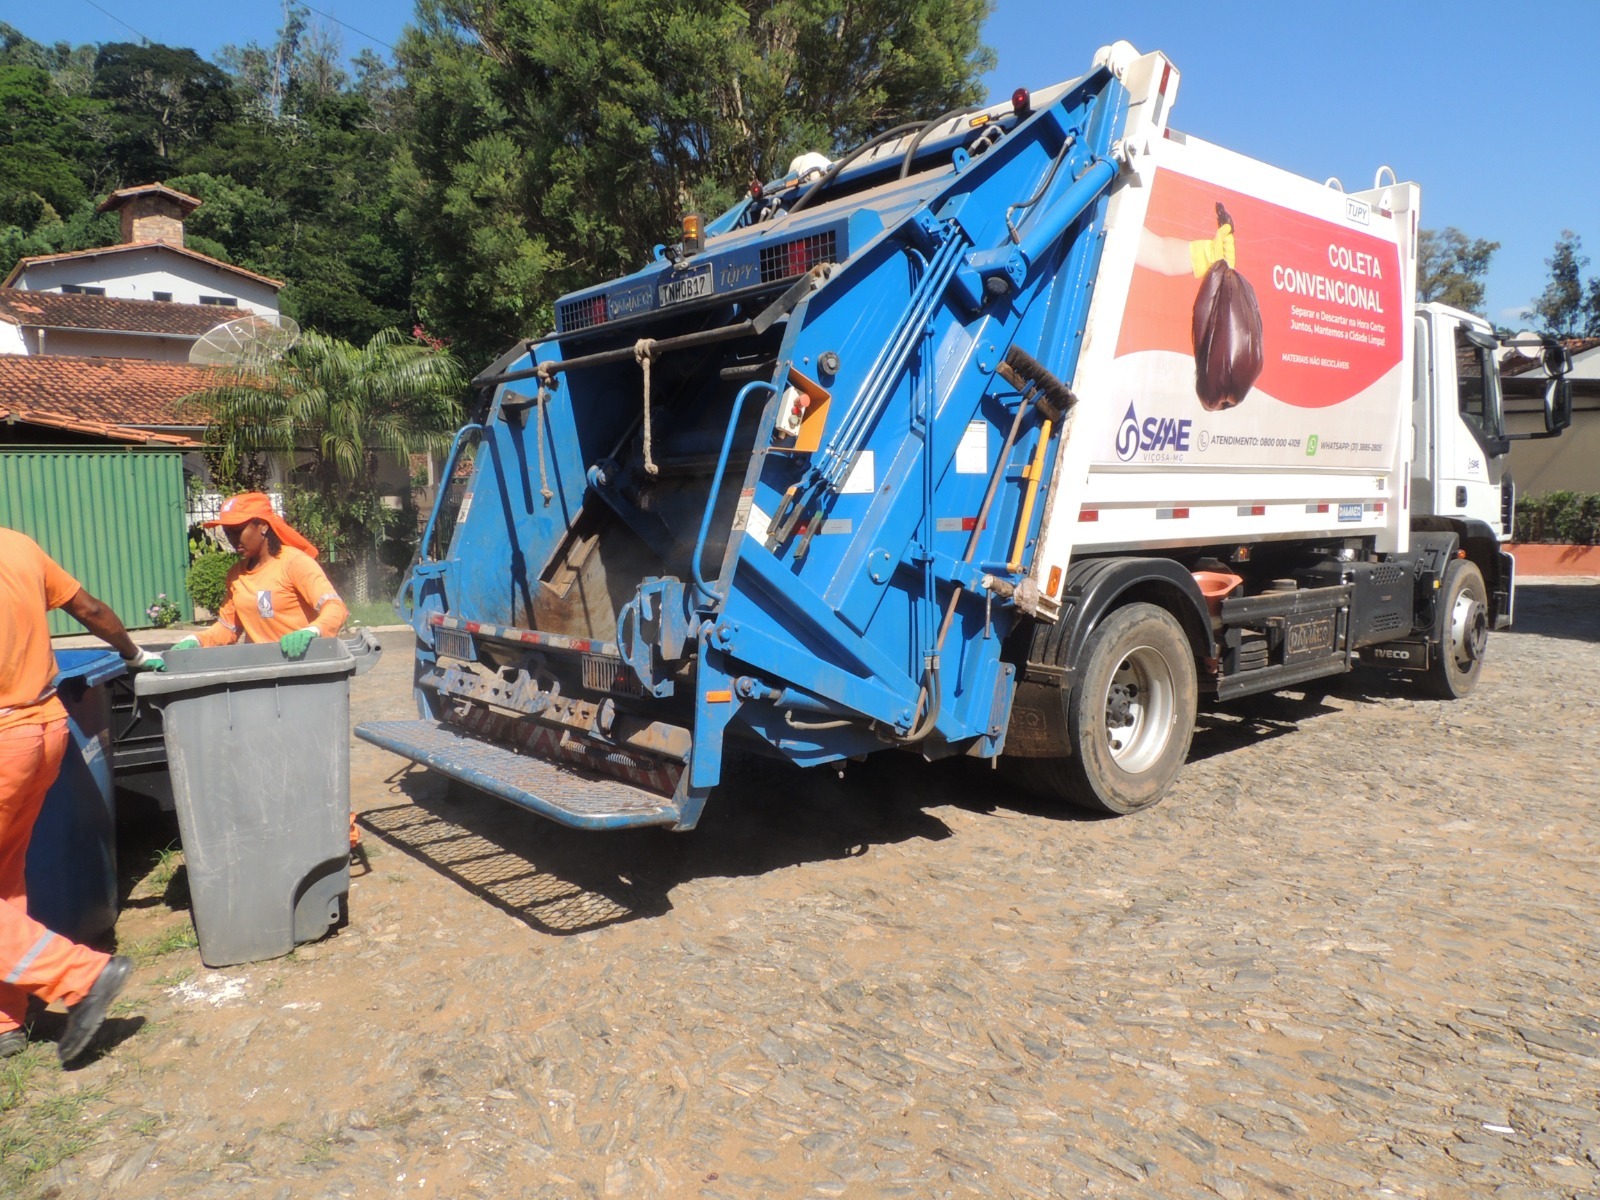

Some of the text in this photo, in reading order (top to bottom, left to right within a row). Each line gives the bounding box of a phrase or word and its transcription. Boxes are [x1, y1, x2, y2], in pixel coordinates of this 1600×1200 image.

[1348, 203, 1367, 220] TUPY
[1328, 243, 1382, 280] COLETA
[720, 264, 753, 286] TUPY
[1273, 264, 1384, 314] CONVENCIONAL
[1291, 304, 1316, 319] Separar
[1315, 311, 1321, 320] e
[1321, 310, 1349, 326] Descartar
[1348, 318, 1357, 328] na
[1356, 318, 1370, 330] Hora
[1290, 319, 1314, 335] Juntos,
[1314, 324, 1345, 339] Mantemos
[1344, 331, 1350, 340] a
[1349, 330, 1369, 344] Cidade
[1282, 352, 1350, 370] MATERIAIS NÃO RECICLÁVEIS
[1140, 417, 1192, 451] SAAE
[1210, 435, 1259, 446] ATENDIMENTO:
[1259, 437, 1275, 447] 0800
[1275, 438, 1287, 447] 000
[1320, 441, 1350, 451] WHATSAPP:
[1143, 453, 1184, 463] VIÇOSA-MG
[1374, 648, 1410, 660] IVECO
